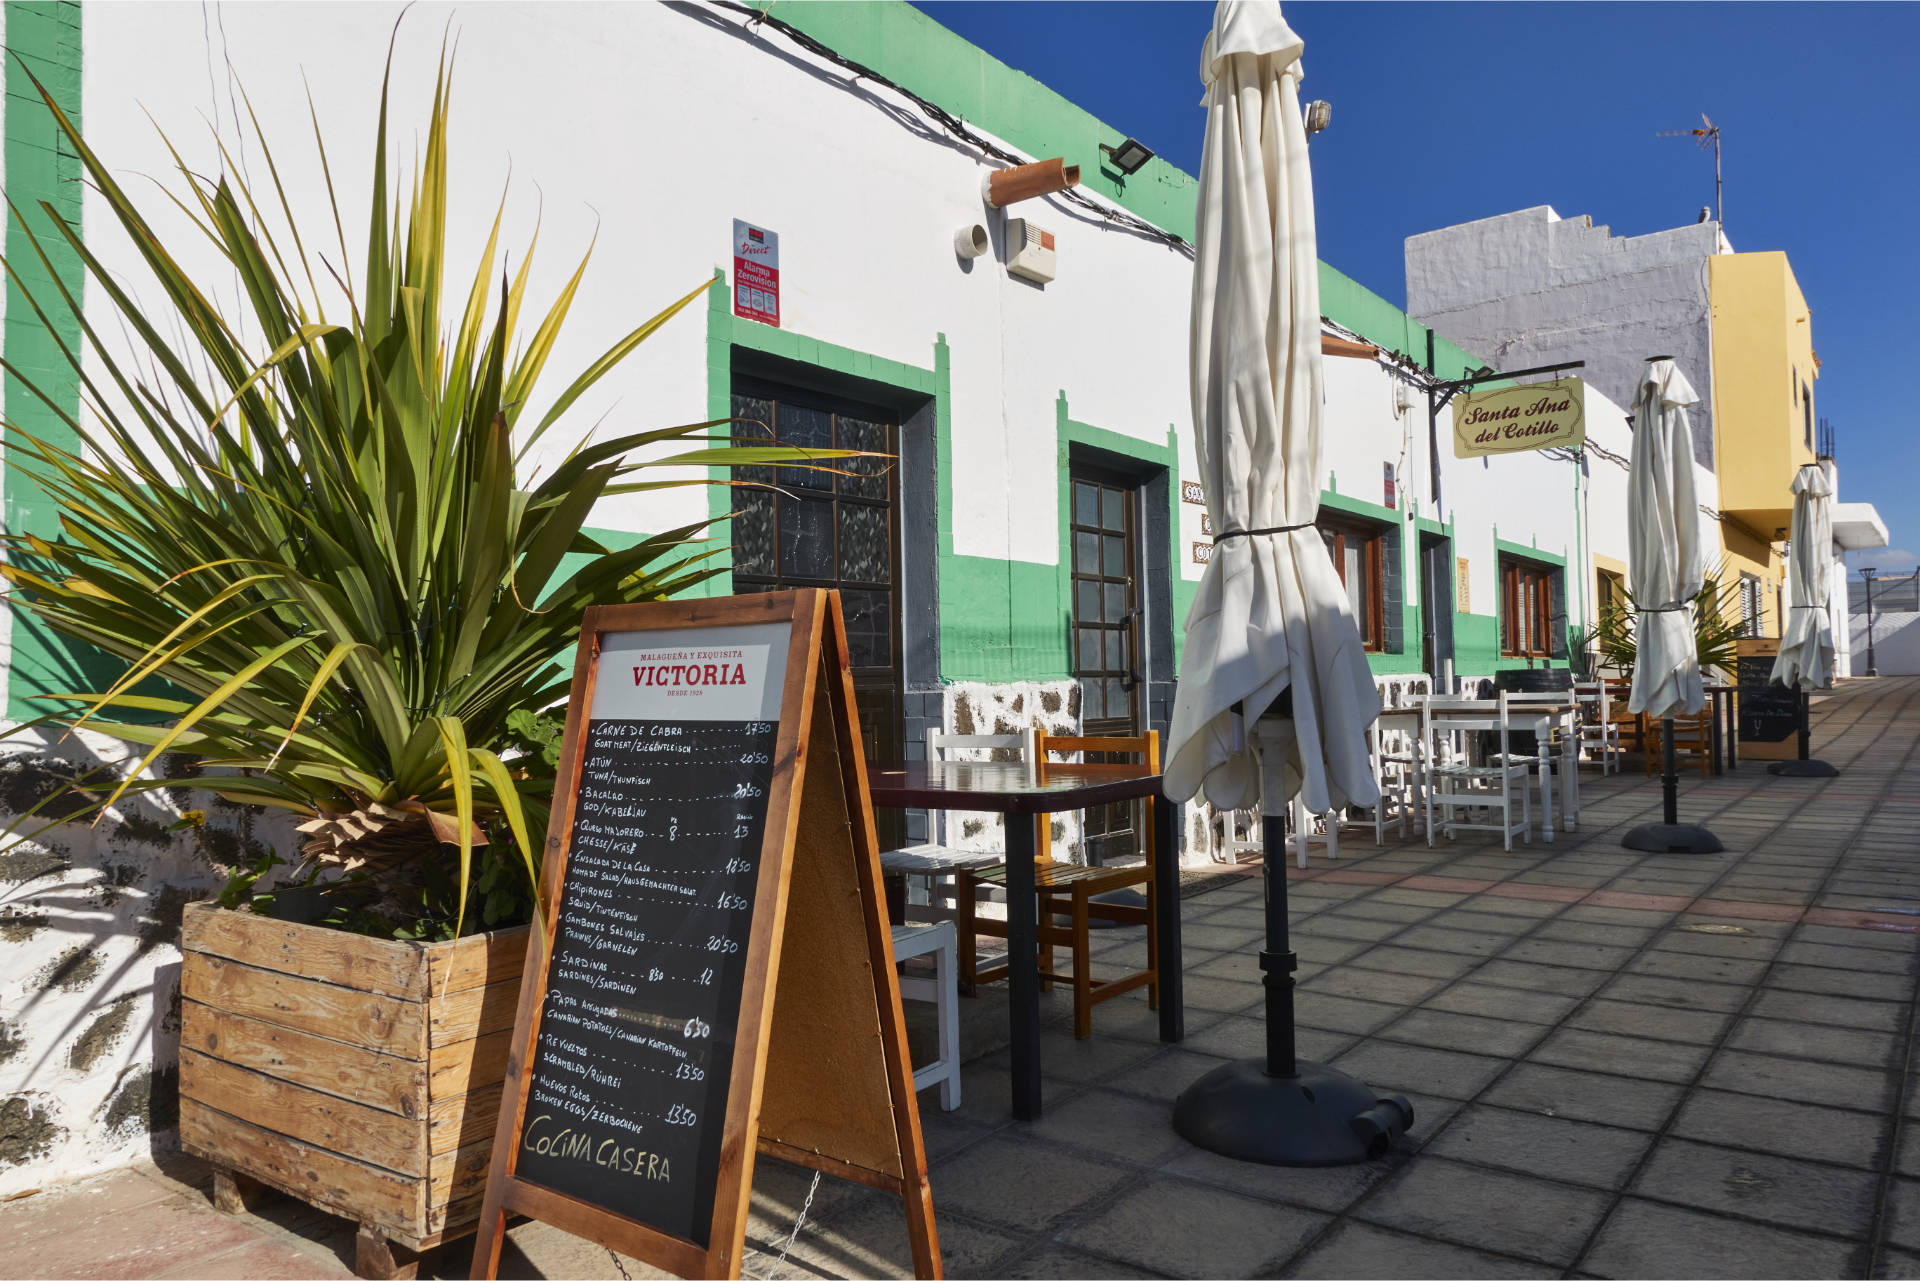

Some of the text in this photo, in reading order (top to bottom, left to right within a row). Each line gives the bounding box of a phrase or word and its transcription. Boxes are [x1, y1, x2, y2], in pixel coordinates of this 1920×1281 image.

[741, 241, 771, 255] Direct
[744, 262, 770, 277] Alarma
[737, 269, 776, 288] Zerovision
[1465, 397, 1571, 424] Santa Ana
[1475, 420, 1560, 443] del Cotillo
[1198, 548, 1211, 558] COT
[640, 652, 688, 661] MALAGUEÑA
[697, 650, 743, 659] EXQUISITA
[632, 663, 746, 686] VICTORIA
[595, 722, 625, 735] CARNE
[629, 726, 643, 735] DE
[650, 726, 682, 736] CABRA
[594, 739, 613, 748] GOAT
[740, 752, 768, 764] 20'50
[585, 786, 623, 801] BACALAO
[669, 825, 678, 842] 8
[733, 824, 749, 838] 13
[612, 859, 622, 868] DE
[717, 891, 748, 910] 16'50
[565, 911, 605, 932] GAMBONES
[707, 934, 738, 954] 20'50
[699, 968, 713, 984] 12
[675, 1062, 705, 1081] 13'50
[535, 1090, 563, 1107] BROKEN
[540, 1075, 567, 1093] HUEVOS
[664, 1103, 696, 1126] 13'50
[596, 1138, 670, 1183] CASERA
